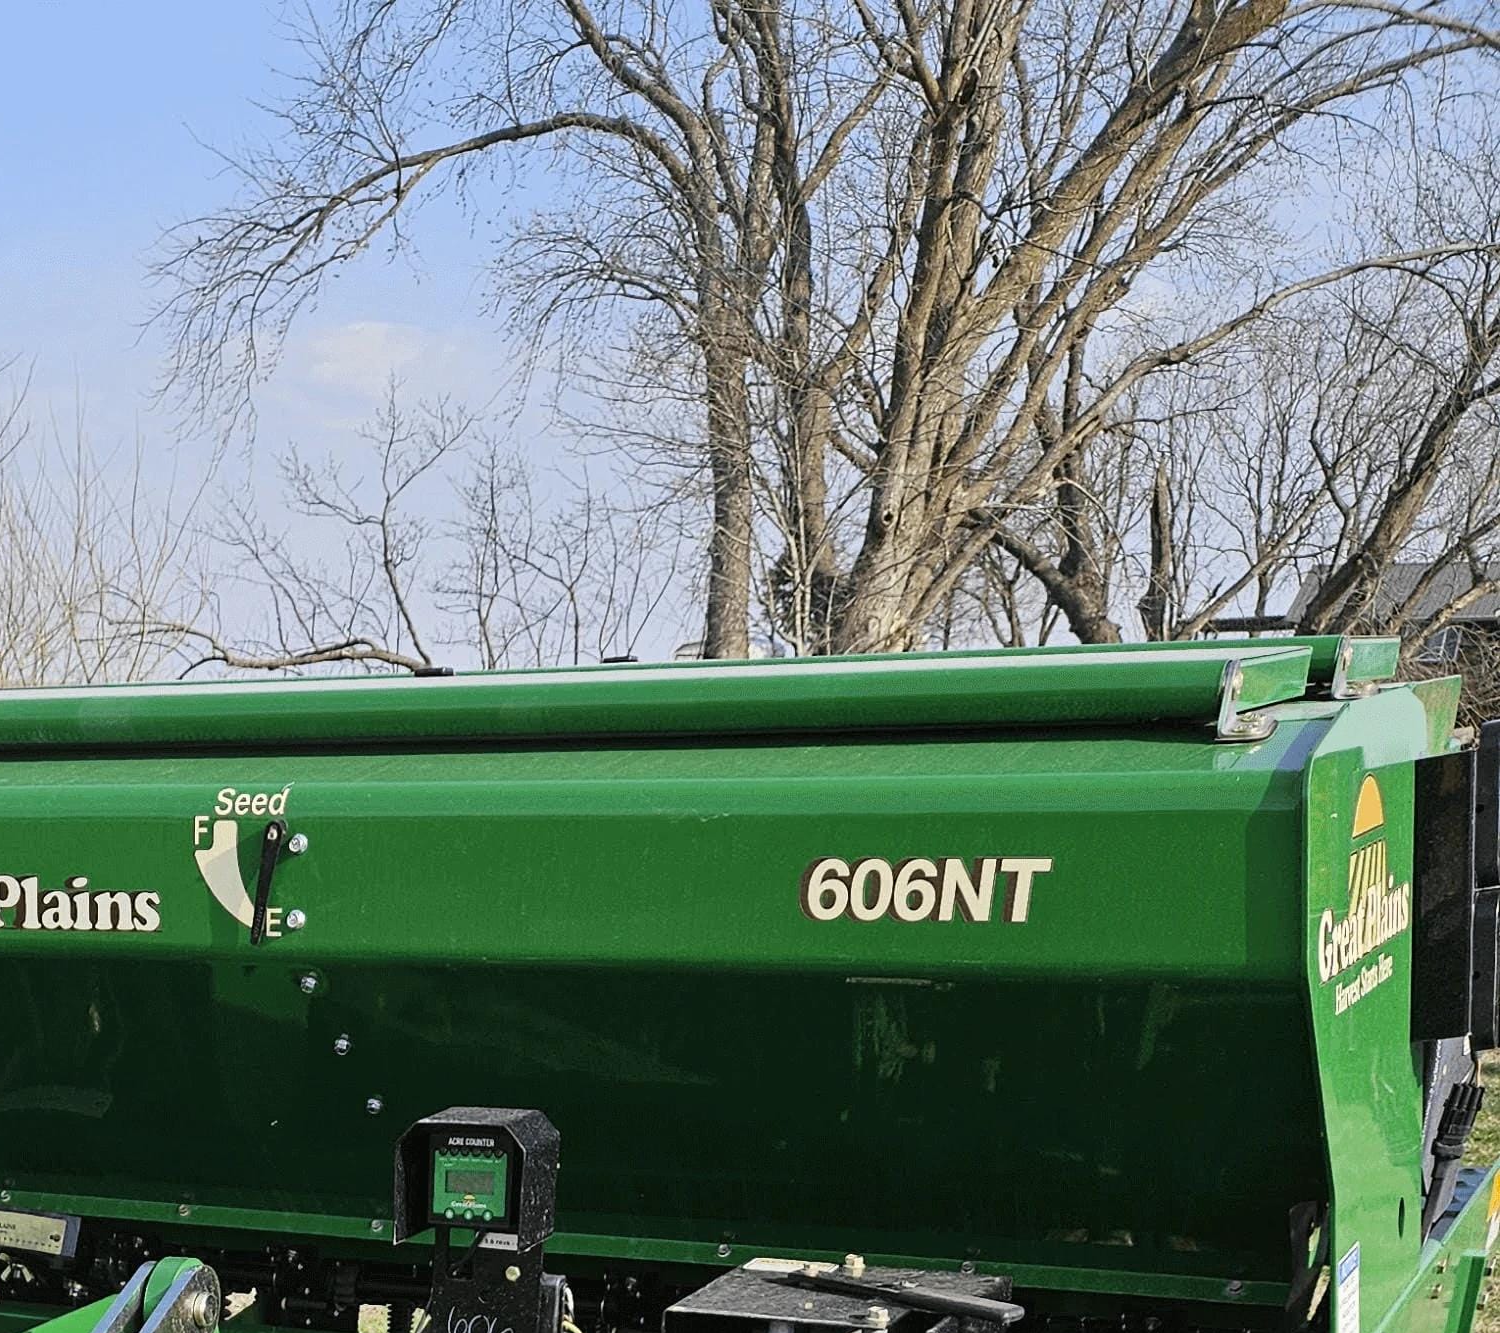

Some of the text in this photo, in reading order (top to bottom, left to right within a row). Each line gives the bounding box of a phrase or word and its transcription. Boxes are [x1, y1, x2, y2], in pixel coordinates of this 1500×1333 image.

[214, 785, 290, 816] Seed
[193, 815, 210, 846] F
[802, 857, 1053, 923] 606NT
[266, 907, 283, 938] E
[1318, 874, 1410, 982] Great Plains
[447, 1137, 495, 1148] ACRE COUNTER
